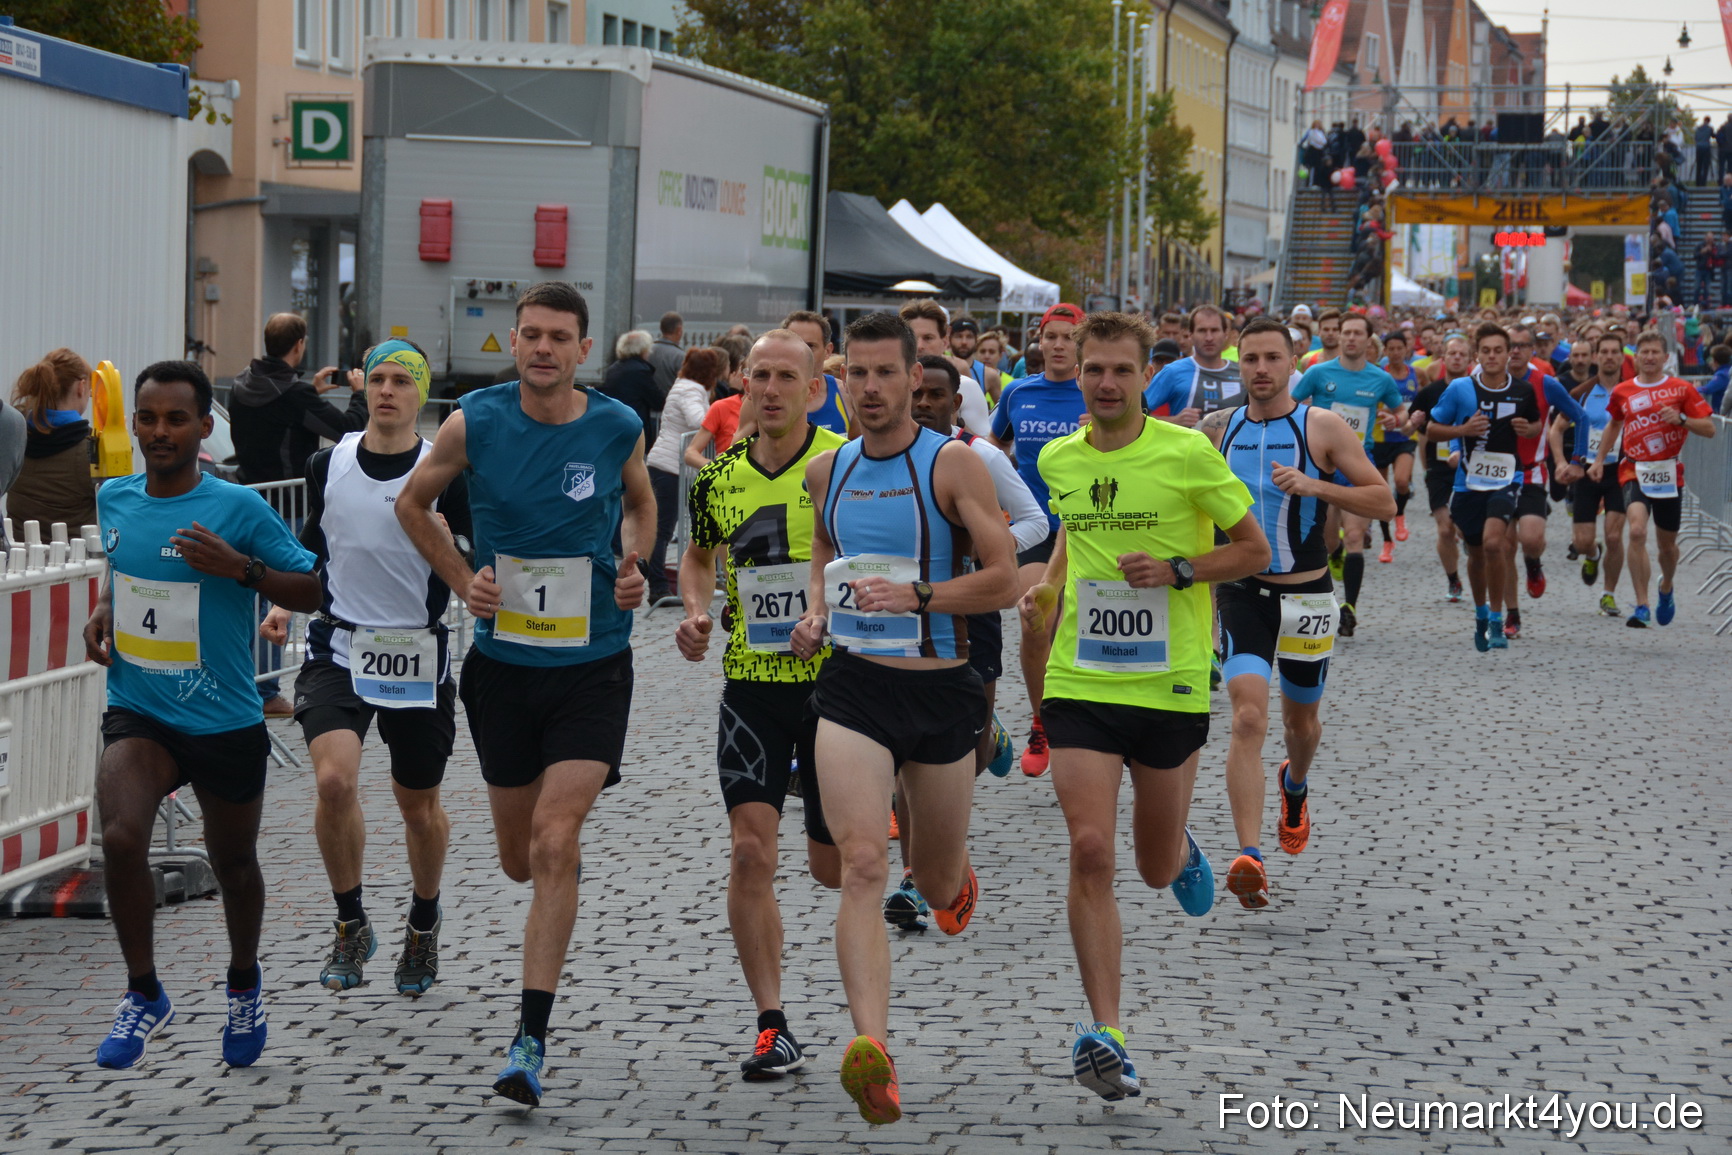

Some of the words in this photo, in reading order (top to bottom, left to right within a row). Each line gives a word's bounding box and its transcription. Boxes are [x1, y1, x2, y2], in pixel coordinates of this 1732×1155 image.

[302, 109, 343, 153] D
[658, 168, 683, 208] OFFICE
[685, 173, 719, 212] INDUSTRY
[719, 179, 747, 216] LOUNGE
[762, 170, 811, 246] BOCK
[1493, 201, 1550, 221] ZIEL
[574, 281, 593, 290] 1106
[1475, 463, 1508, 478] 2135
[571, 470, 587, 489] TSV
[1641, 472, 1670, 483] 2435
[573, 480, 591, 498] 1965
[799, 496, 812, 504] Pa
[532, 566, 565, 575] BOCK
[857, 562, 890, 572] BOCK
[765, 571, 795, 582] BOCK
[139, 586, 171, 598] BOCK
[534, 585, 546, 611] 1
[1106, 589, 1139, 598] BOCK
[752, 589, 808, 618] 2671
[142, 608, 158, 634] 4
[526, 620, 556, 631] Stefan
[856, 621, 885, 632] Marco
[1088, 608, 1153, 636] 2000
[1297, 614, 1331, 635] 275
[770, 626, 795, 637] Floria
[383, 635, 413, 644] BOCK
[1102, 645, 1138, 657] Michael
[361, 651, 420, 677] 2001
[379, 684, 406, 694] Stefan
